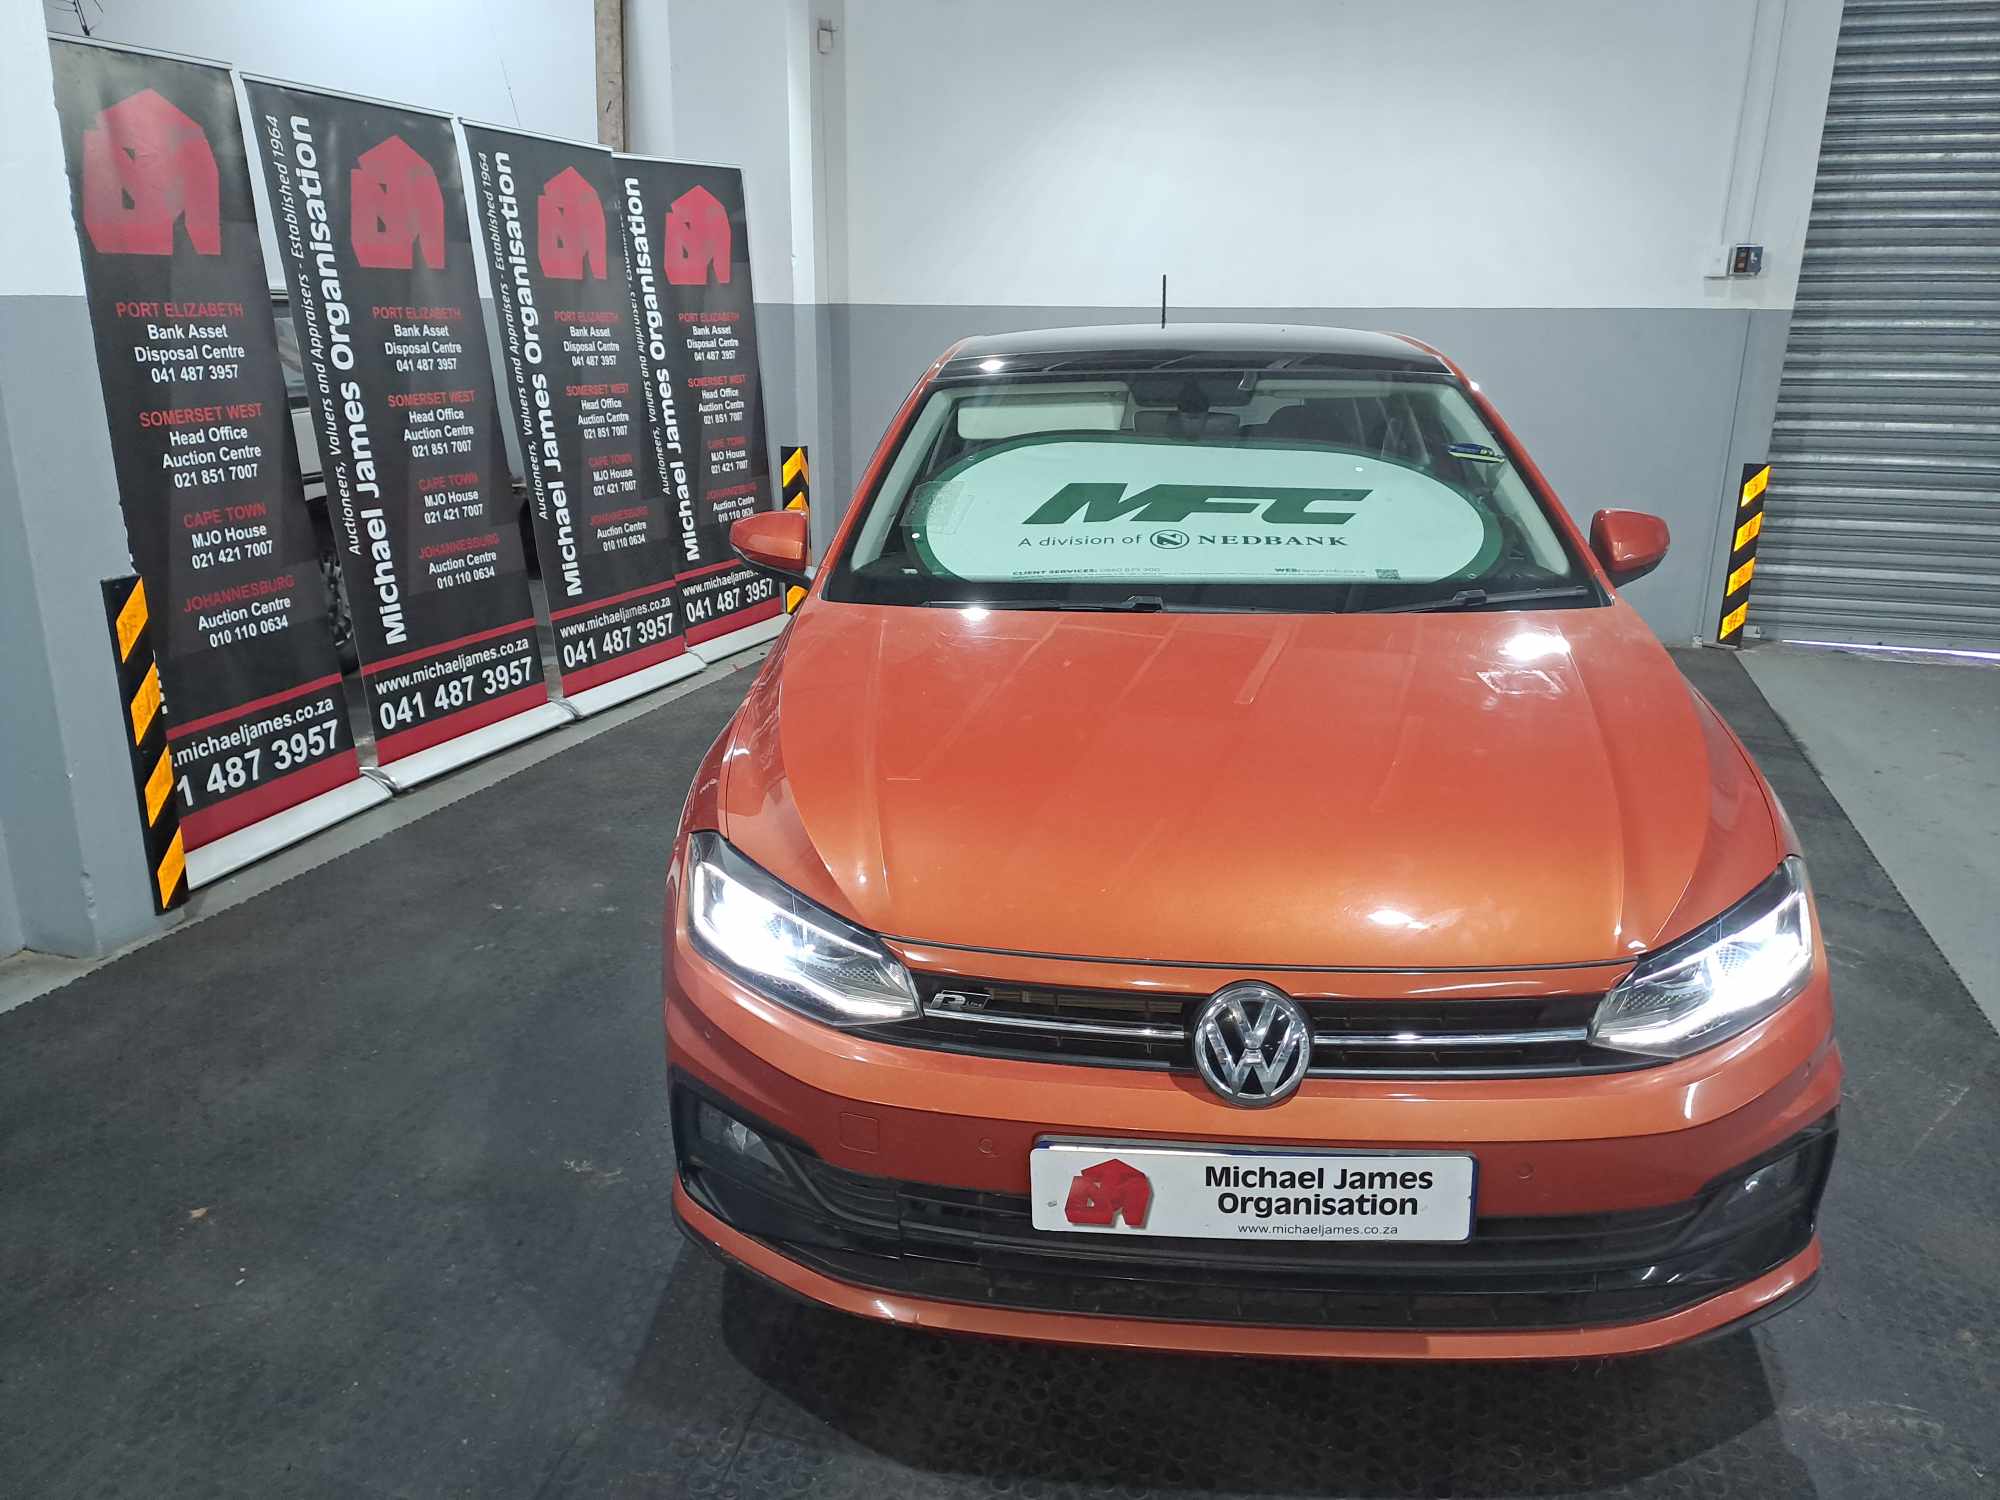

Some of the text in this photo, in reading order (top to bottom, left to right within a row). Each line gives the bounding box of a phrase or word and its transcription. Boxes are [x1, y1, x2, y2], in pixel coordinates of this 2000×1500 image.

[624, 177, 665, 361] Organisation
[116, 302, 244, 318] PORT ELIZABETH
[372, 307, 462, 320] PORT ELIZABETH
[147, 324, 229, 340] Bank Asset
[265, 114, 361, 555] Auctioneers, Valuers and Appraisers Established 1964
[394, 324, 449, 337] Bank Asset
[478, 151, 549, 520] Auctioneers, Valuers and Appraisers Established 1964
[570, 326, 611, 337] Bank Asset
[134, 344, 245, 365] Disposal Centre
[385, 341, 462, 356] Disposal Centre
[563, 341, 620, 354] Disposal Centre
[396, 358, 457, 372] 041 487 3957
[572, 355, 616, 366] 041 487 3957
[151, 364, 239, 384] 041 487 3957
[290, 115, 407, 646] Michael James Organisation
[495, 151, 583, 597] Michael James Organisation
[388, 390, 475, 408] SOMERSET WEST
[581, 398, 622, 410] Head Office
[656, 368, 681, 454] James
[139, 403, 263, 428] SOMERSET WEST
[409, 408, 464, 423] Head Office
[578, 412, 629, 425] Auction Centre
[169, 425, 248, 446] Head Office
[404, 424, 474, 441] Auction Centre
[584, 428, 596, 439] 021
[598, 427, 610, 438] 851
[644, 380, 671, 496] Auctioneers, Valuers
[162, 445, 262, 469] Auction Centre
[412, 440, 472, 457] 021 851 7007
[174, 463, 258, 489] 021 851 7007
[419, 472, 479, 492] CAPE TOWN
[593, 469, 632, 481] MJO House
[424, 490, 479, 508] MJO House
[593, 480, 636, 496] 021 421 7007
[184, 503, 267, 528] CAPE TOWN
[424, 503, 483, 525] 021 421 7007
[669, 460, 700, 562] Michael
[1021, 482, 1374, 525] MFC
[191, 524, 267, 549] MJO House
[597, 521, 646, 538] Auction Centre
[629, 533, 645, 544] 0634
[1018, 533, 1349, 548] A division of NEDBANK
[192, 540, 273, 569] 021 421 7007
[429, 550, 497, 575] Auction Centre
[437, 566, 495, 590] 010 110 0634
[184, 575, 295, 613] JOHANNESBURG
[686, 578, 773, 623] 041 487 3957
[198, 596, 291, 631] Auction Centre
[560, 596, 670, 638] www.michaeljames.co.za
[209, 614, 288, 648] 010 110 0634
[563, 613, 673, 668] 041 487 3957
[376, 636, 529, 696] www.michaeljames.co.za
[379, 656, 532, 730] 041 487 3957
[170, 697, 334, 768] .michaeljames.co.za
[206, 747, 261, 794] 487
[271, 719, 338, 771] 3957
[1205, 1165, 1433, 1190] Michael James
[1217, 1192, 1419, 1218] Organisation
[1237, 1223, 1398, 1237] www.michaeljames.co.za
